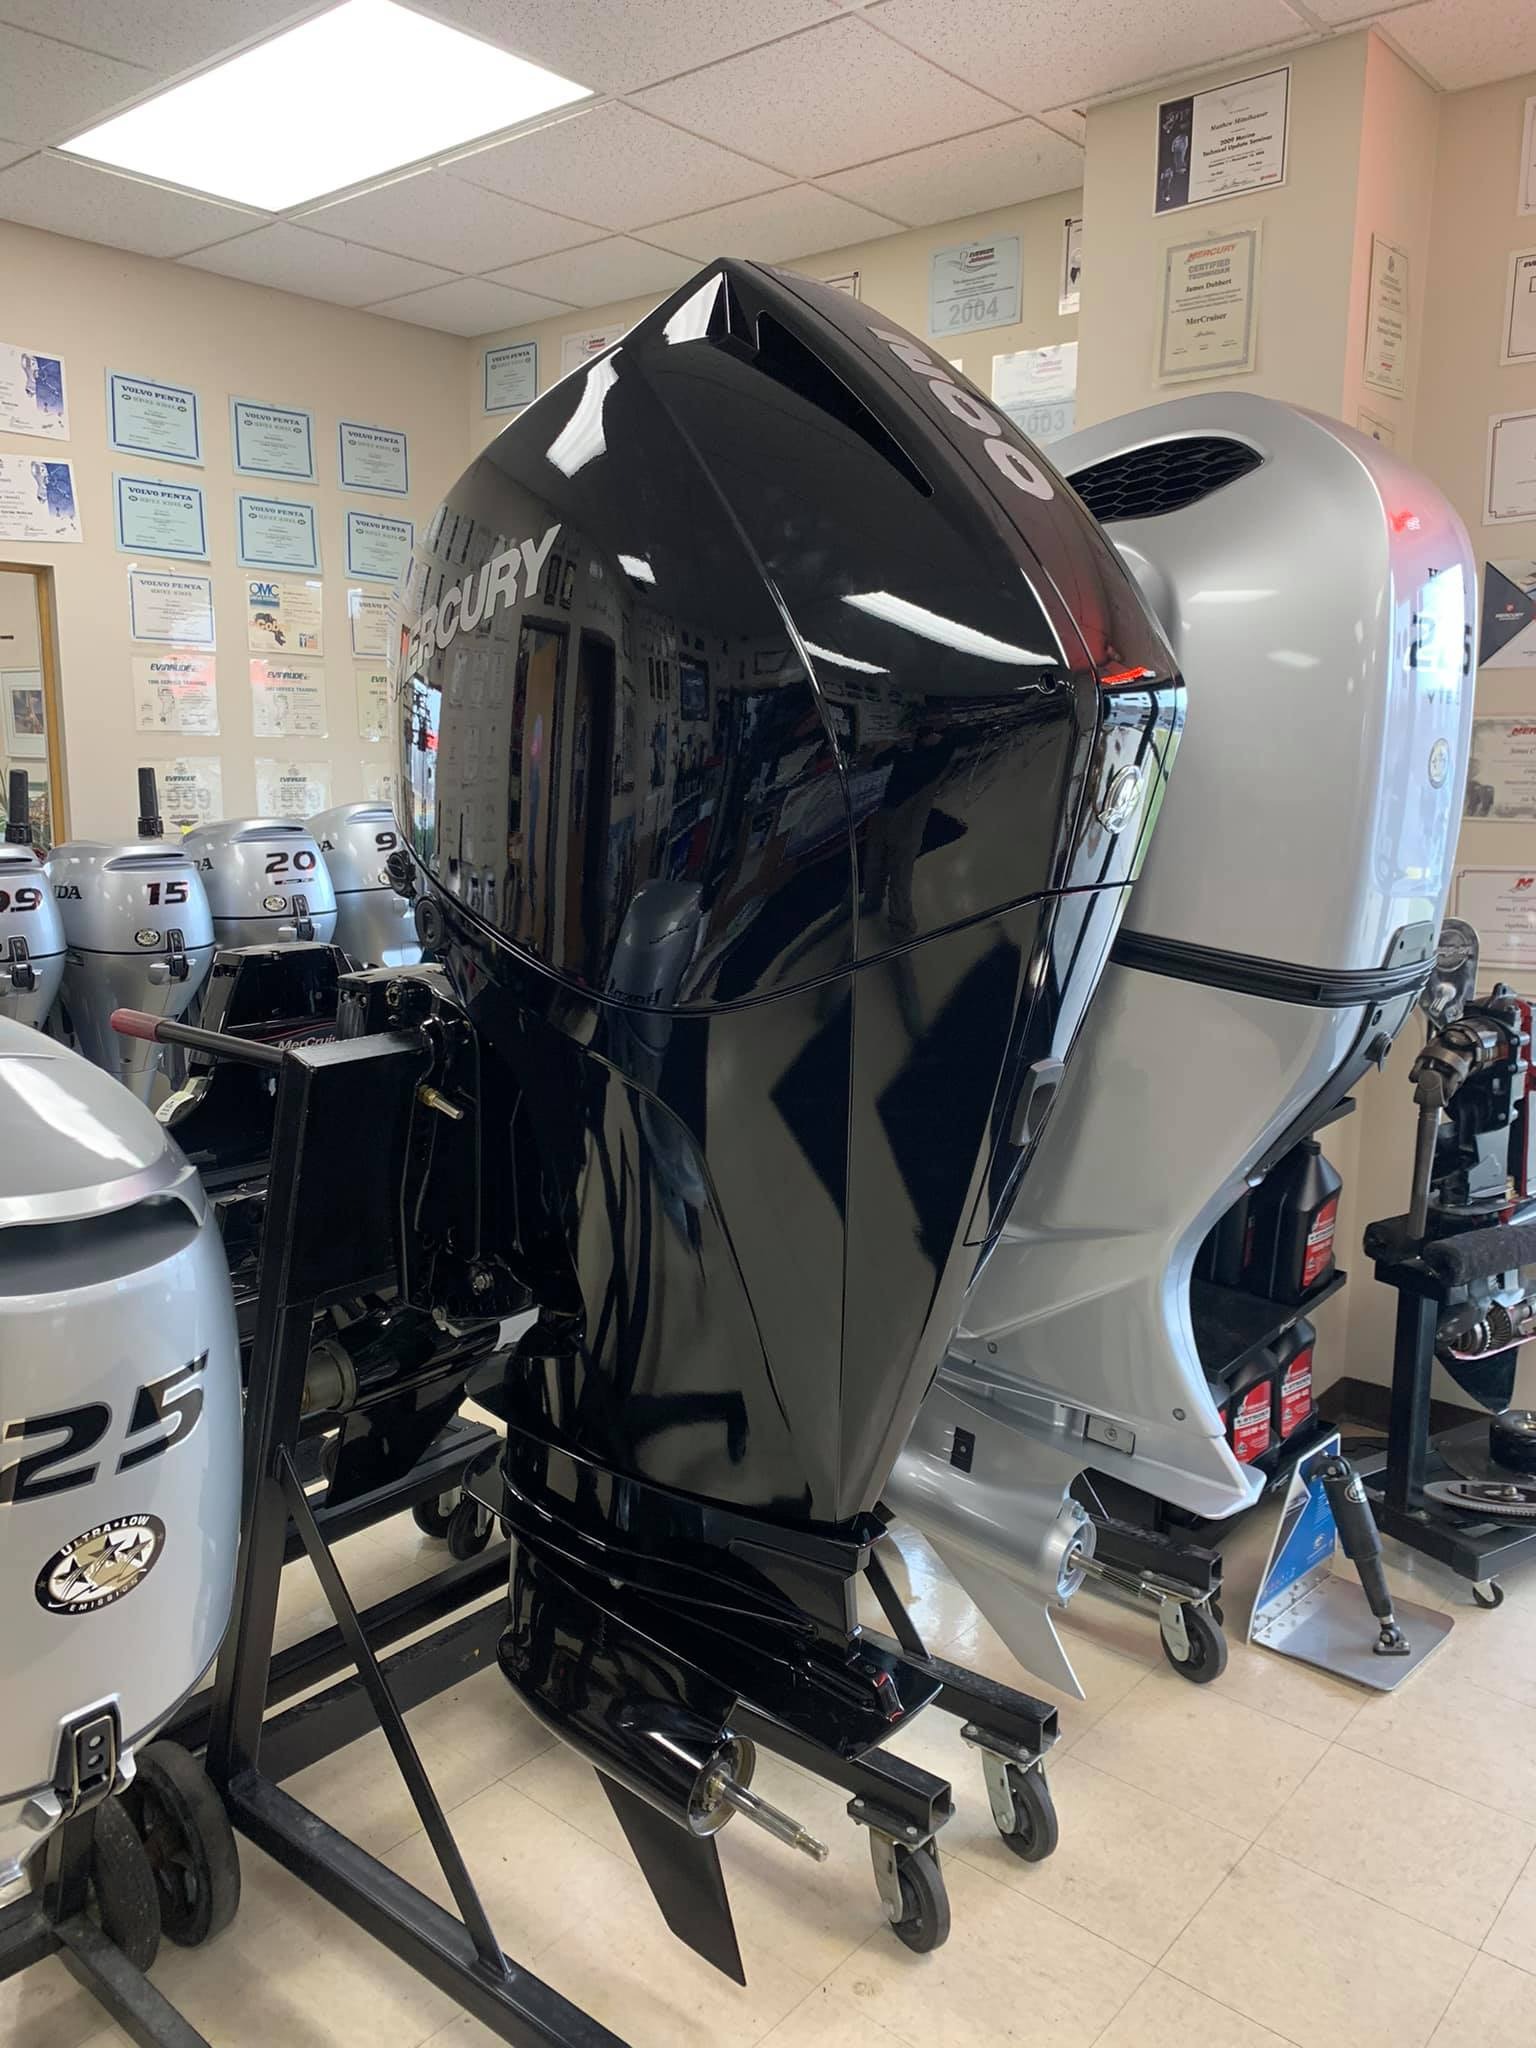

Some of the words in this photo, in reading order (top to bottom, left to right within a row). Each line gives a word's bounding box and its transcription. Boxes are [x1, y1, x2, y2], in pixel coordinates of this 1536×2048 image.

[1186, 243, 1236, 262] MERCURY
[949, 296, 999, 325] 2004
[1185, 312, 1228, 325] MerCruiser
[121, 385, 153, 397] VOLVO
[154, 392, 187, 404] PENTA
[244, 412, 272, 421] VOLVO
[272, 416, 301, 426] PENTA
[348, 431, 373, 440] VOLVO
[374, 435, 400, 444] PENTA
[128, 486, 159, 497] VOLVO
[160, 492, 193, 501] PENTA
[249, 505, 276, 514] VOLVO
[277, 509, 304, 518] PENTA
[355, 520, 380, 529] VOLVO
[380, 524, 406, 533] PENTA
[140, 580, 170, 588] VOLVO
[171, 582, 202, 591] PENTA
[249, 582, 280, 597] OMC
[400, 523, 562, 689] ERCURY
[265, 850, 317, 874] 20
[146, 881, 189, 906] 15
[0, 1349, 210, 1505] 25
[69, 1578, 139, 1613] EMISSION
